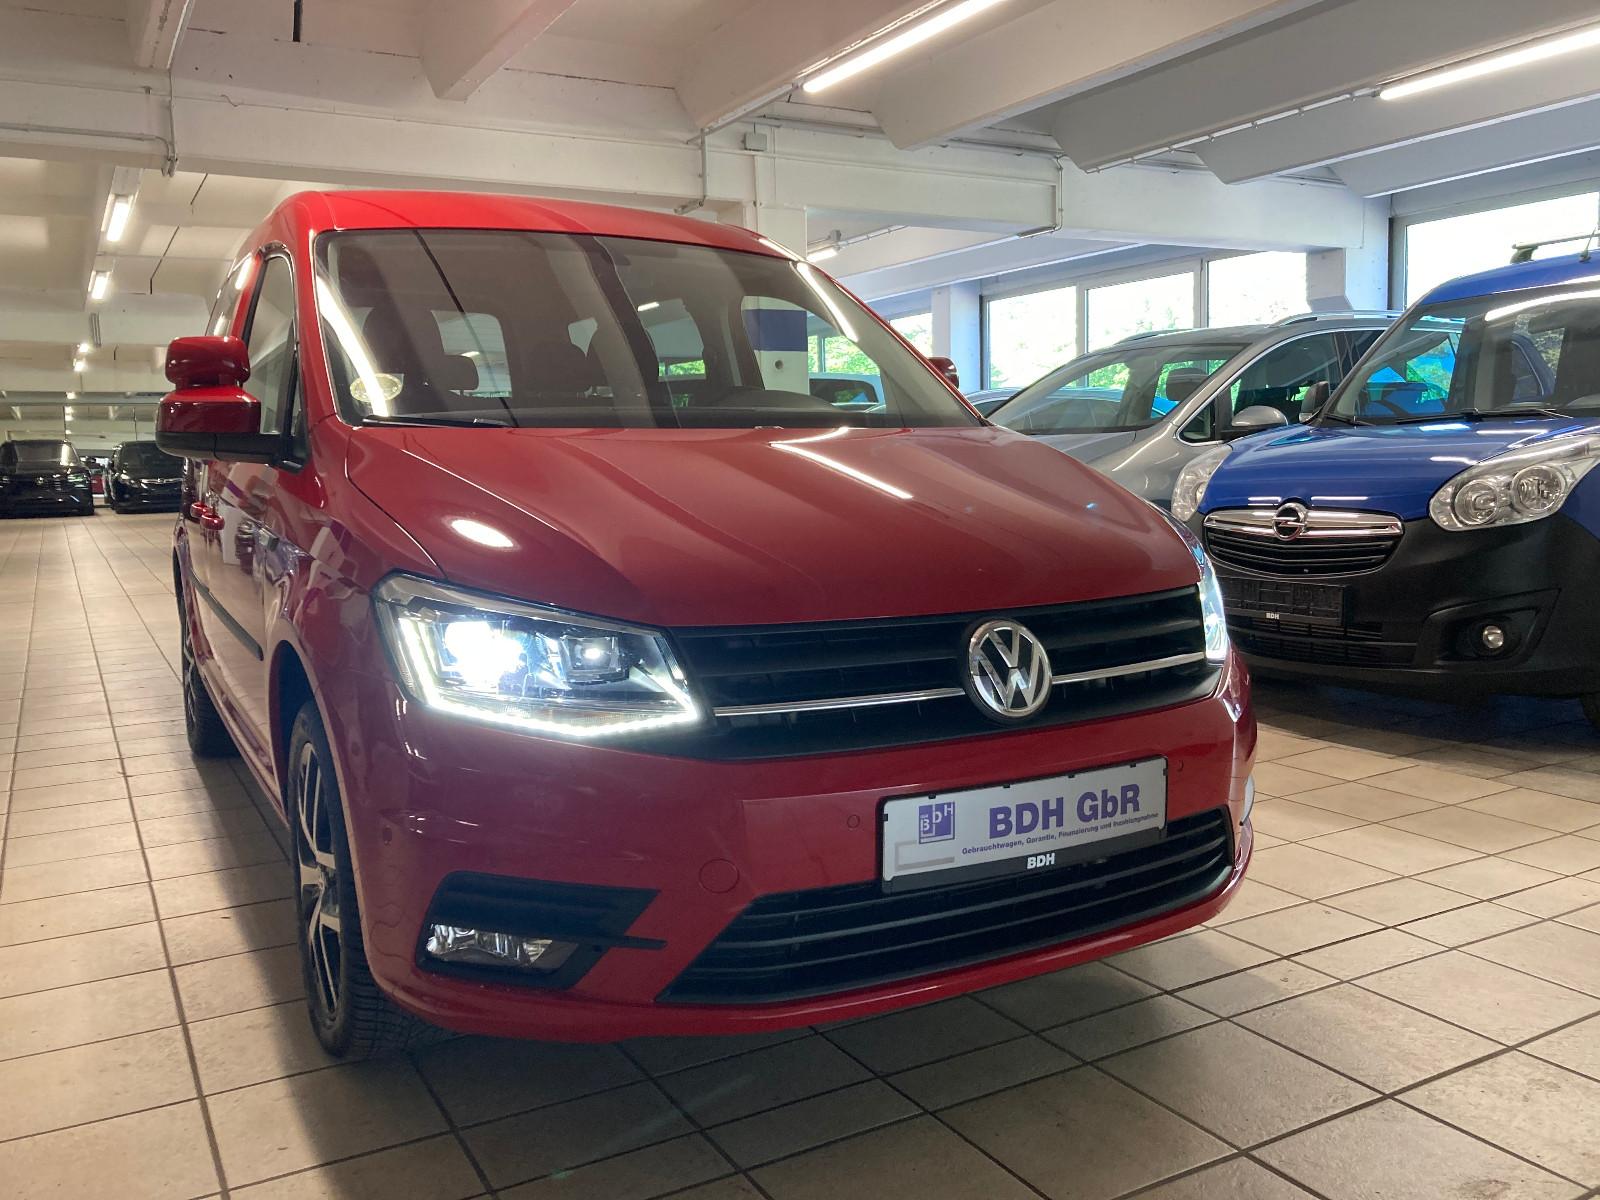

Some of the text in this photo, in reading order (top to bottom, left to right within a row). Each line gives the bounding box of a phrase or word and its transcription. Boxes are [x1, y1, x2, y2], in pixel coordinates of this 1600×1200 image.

[989, 783, 1140, 839] BDH GbR
[961, 839, 1025, 855] Gebrauchtwagen,
[1026, 833, 1057, 845] Garantie,
[1058, 823, 1099, 839] Finanzierung
[1026, 853, 1056, 870] BDH
